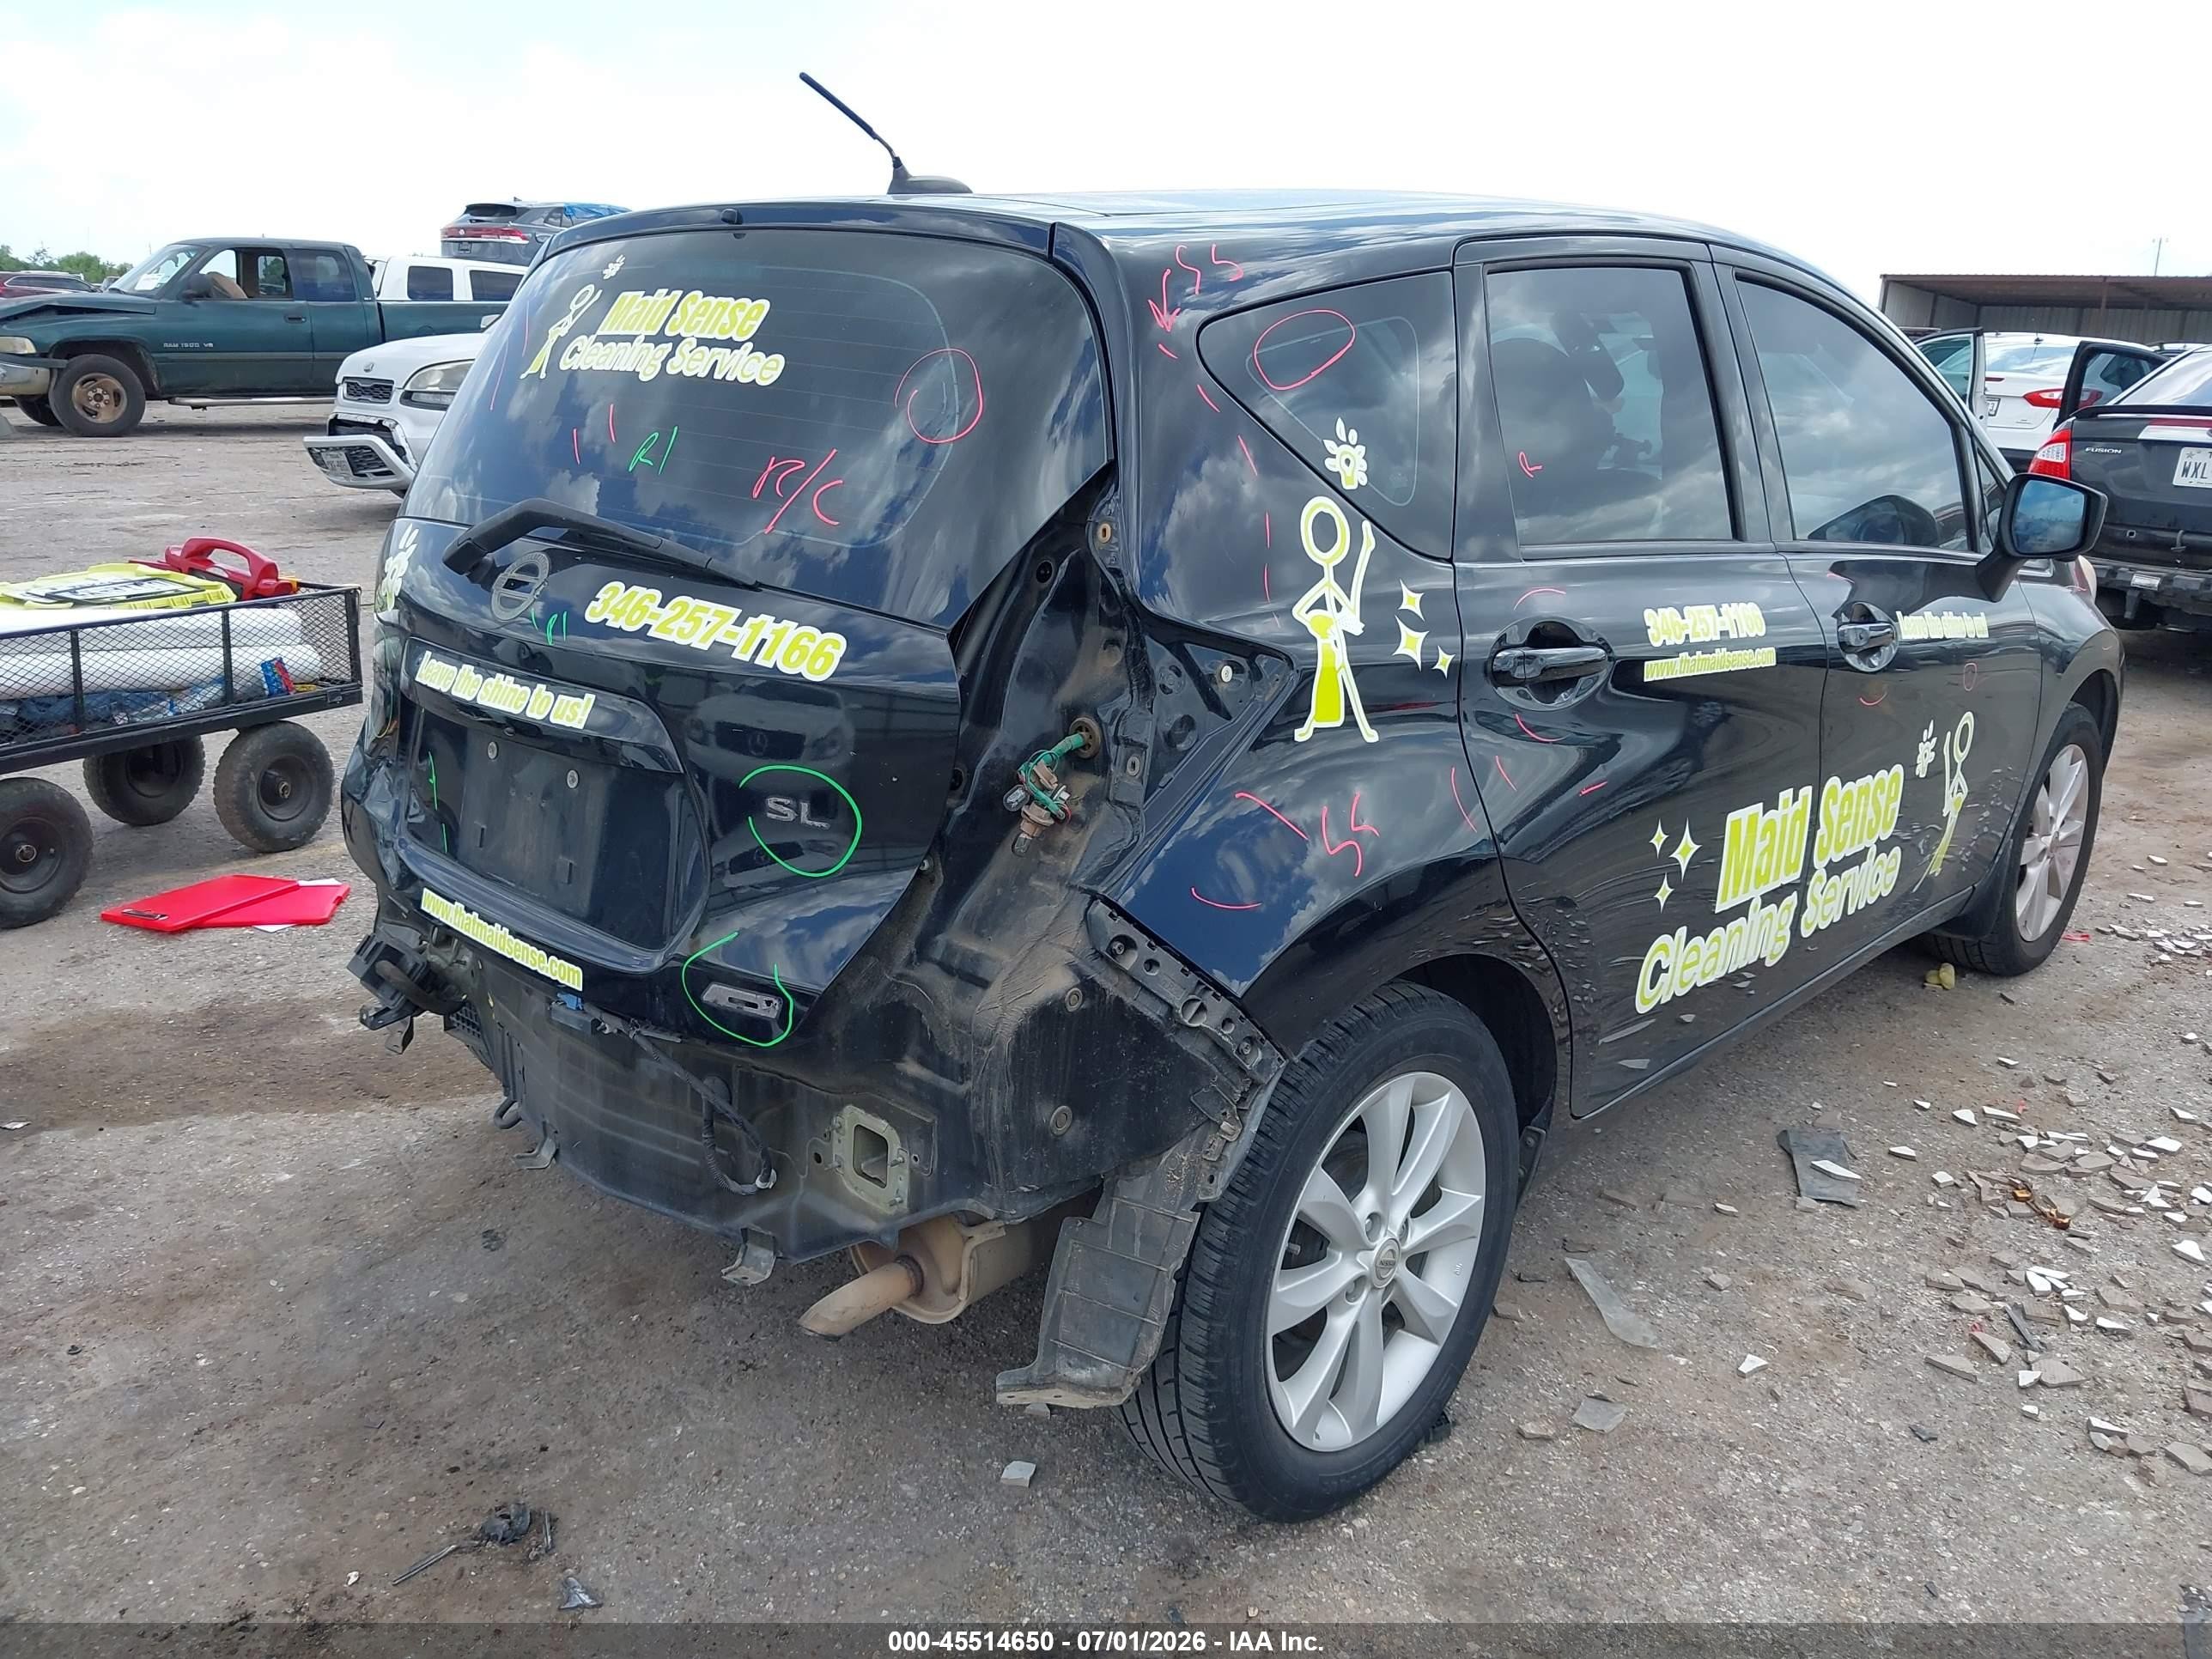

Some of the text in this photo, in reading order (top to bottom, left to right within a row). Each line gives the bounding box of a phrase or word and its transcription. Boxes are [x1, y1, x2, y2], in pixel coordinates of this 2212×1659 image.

[599, 289, 770, 342] Maid Sense
[560, 334, 785, 386] Cleaning Service
[585, 581, 847, 682] 346-257-1166
[1644, 602, 1765, 647] 346-257-1166
[415, 650, 596, 729] Leave the shine to us!
[1644, 647, 1777, 682] www.thatmaidsense.com
[767, 797, 831, 830] SL
[1715, 764, 1904, 914] Maid Sense
[421, 888, 583, 992] www.thatmaidsense.com
[1635, 844, 1901, 1014] Cleaning Service
